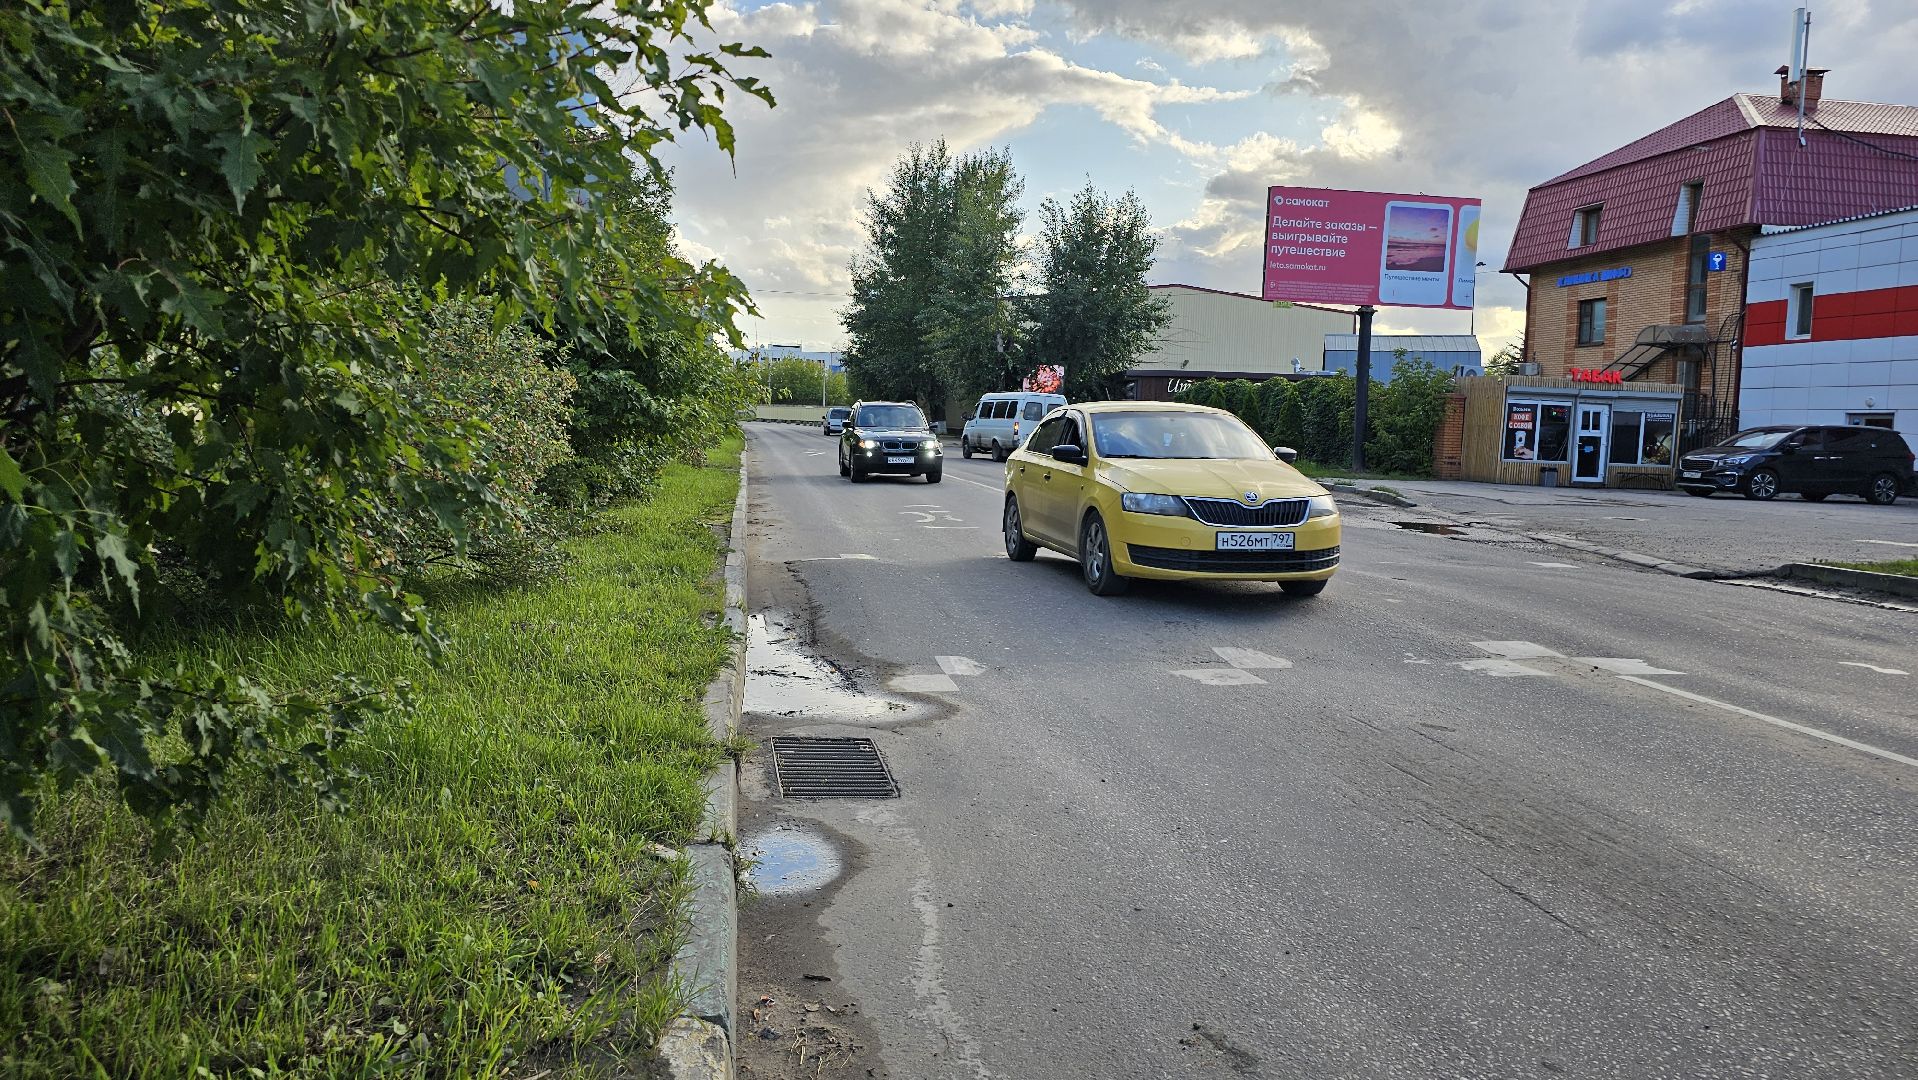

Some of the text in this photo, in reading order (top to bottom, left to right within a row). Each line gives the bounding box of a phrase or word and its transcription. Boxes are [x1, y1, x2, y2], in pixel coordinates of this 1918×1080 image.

[1285, 198, 1330, 208] самокат
[1272, 215, 1322, 229] Делайте
[1324, 222, 1366, 231] заказы
[1271, 232, 1348, 244] выигрывайте
[1270, 245, 1346, 258] путешествие
[1269, 261, 1326, 271] leto.samokat.ru
[1569, 367, 1623, 384] ТАБАК
[1221, 533, 1291, 547] Н526МТ 797
